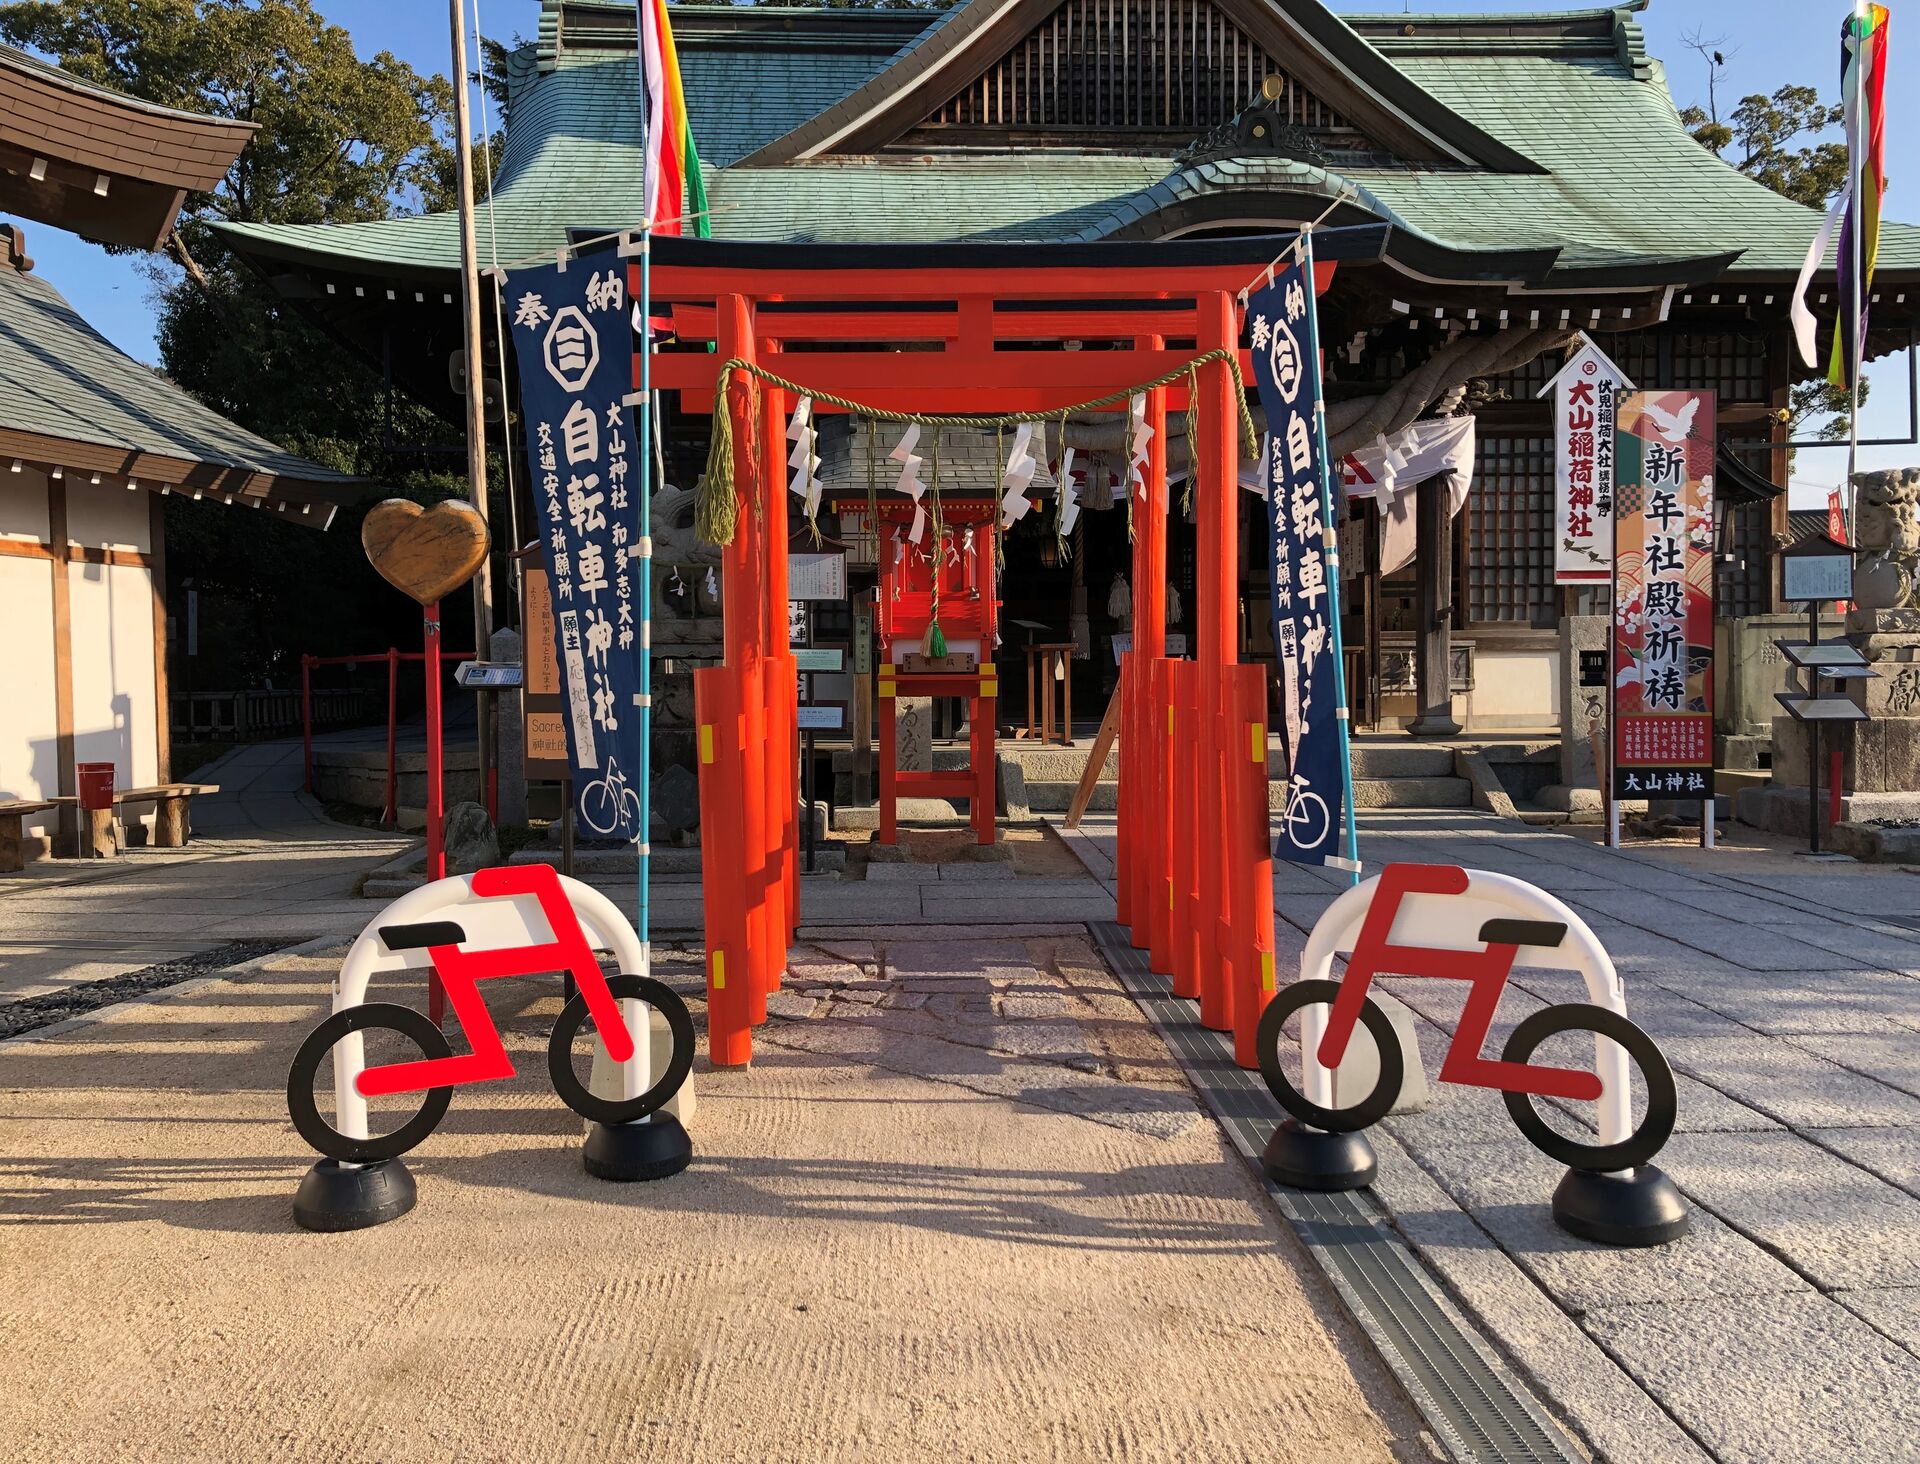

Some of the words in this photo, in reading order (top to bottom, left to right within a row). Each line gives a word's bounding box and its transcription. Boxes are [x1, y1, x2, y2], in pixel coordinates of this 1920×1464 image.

[606, 402, 629, 510] 大山神社
[1567, 379, 1594, 538] 大山稲荷神社
[560, 400, 618, 733] 自転車神社
[1644, 442, 1686, 711] 新年社殿祈祷
[562, 615, 580, 650] 願主
[1280, 623, 1296, 659] 願主
[1624, 772, 1705, 792] 大山神社
